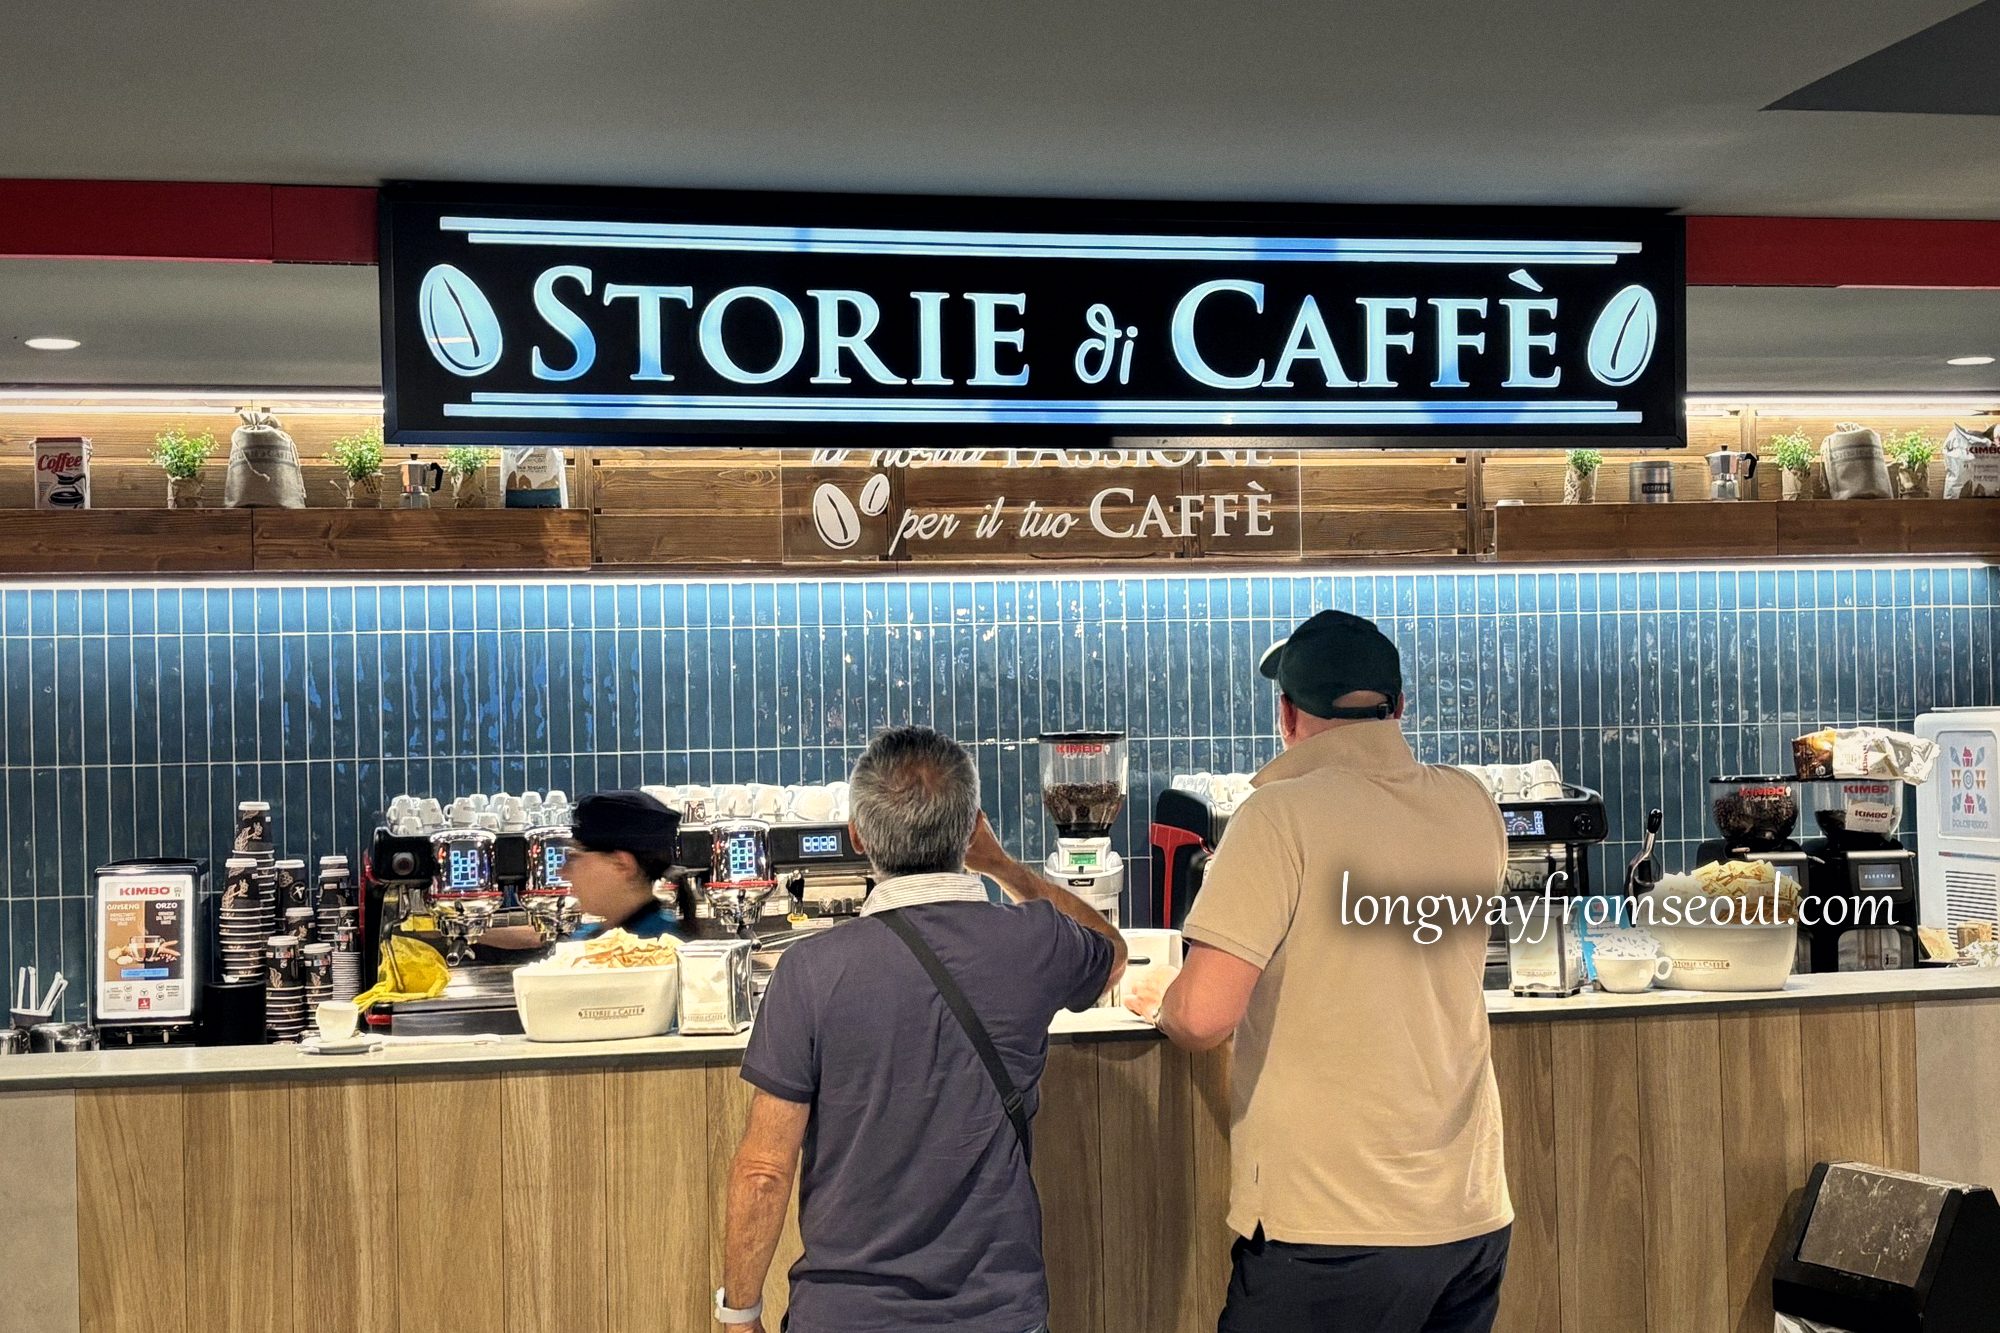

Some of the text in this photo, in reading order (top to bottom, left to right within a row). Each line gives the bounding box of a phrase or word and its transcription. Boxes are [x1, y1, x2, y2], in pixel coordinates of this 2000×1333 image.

[531, 265, 1562, 390] STORIE di CAFFÈ
[37, 452, 83, 474] Coffee
[889, 480, 1275, 556] per il tuo CAFFÈ
[1056, 744, 1102, 752] KIMBO
[1843, 785, 1890, 794] KIMBO
[1854, 810, 1888, 819] KIMBO
[119, 886, 171, 896] KIMBO
[155, 902, 178, 910] ORZO
